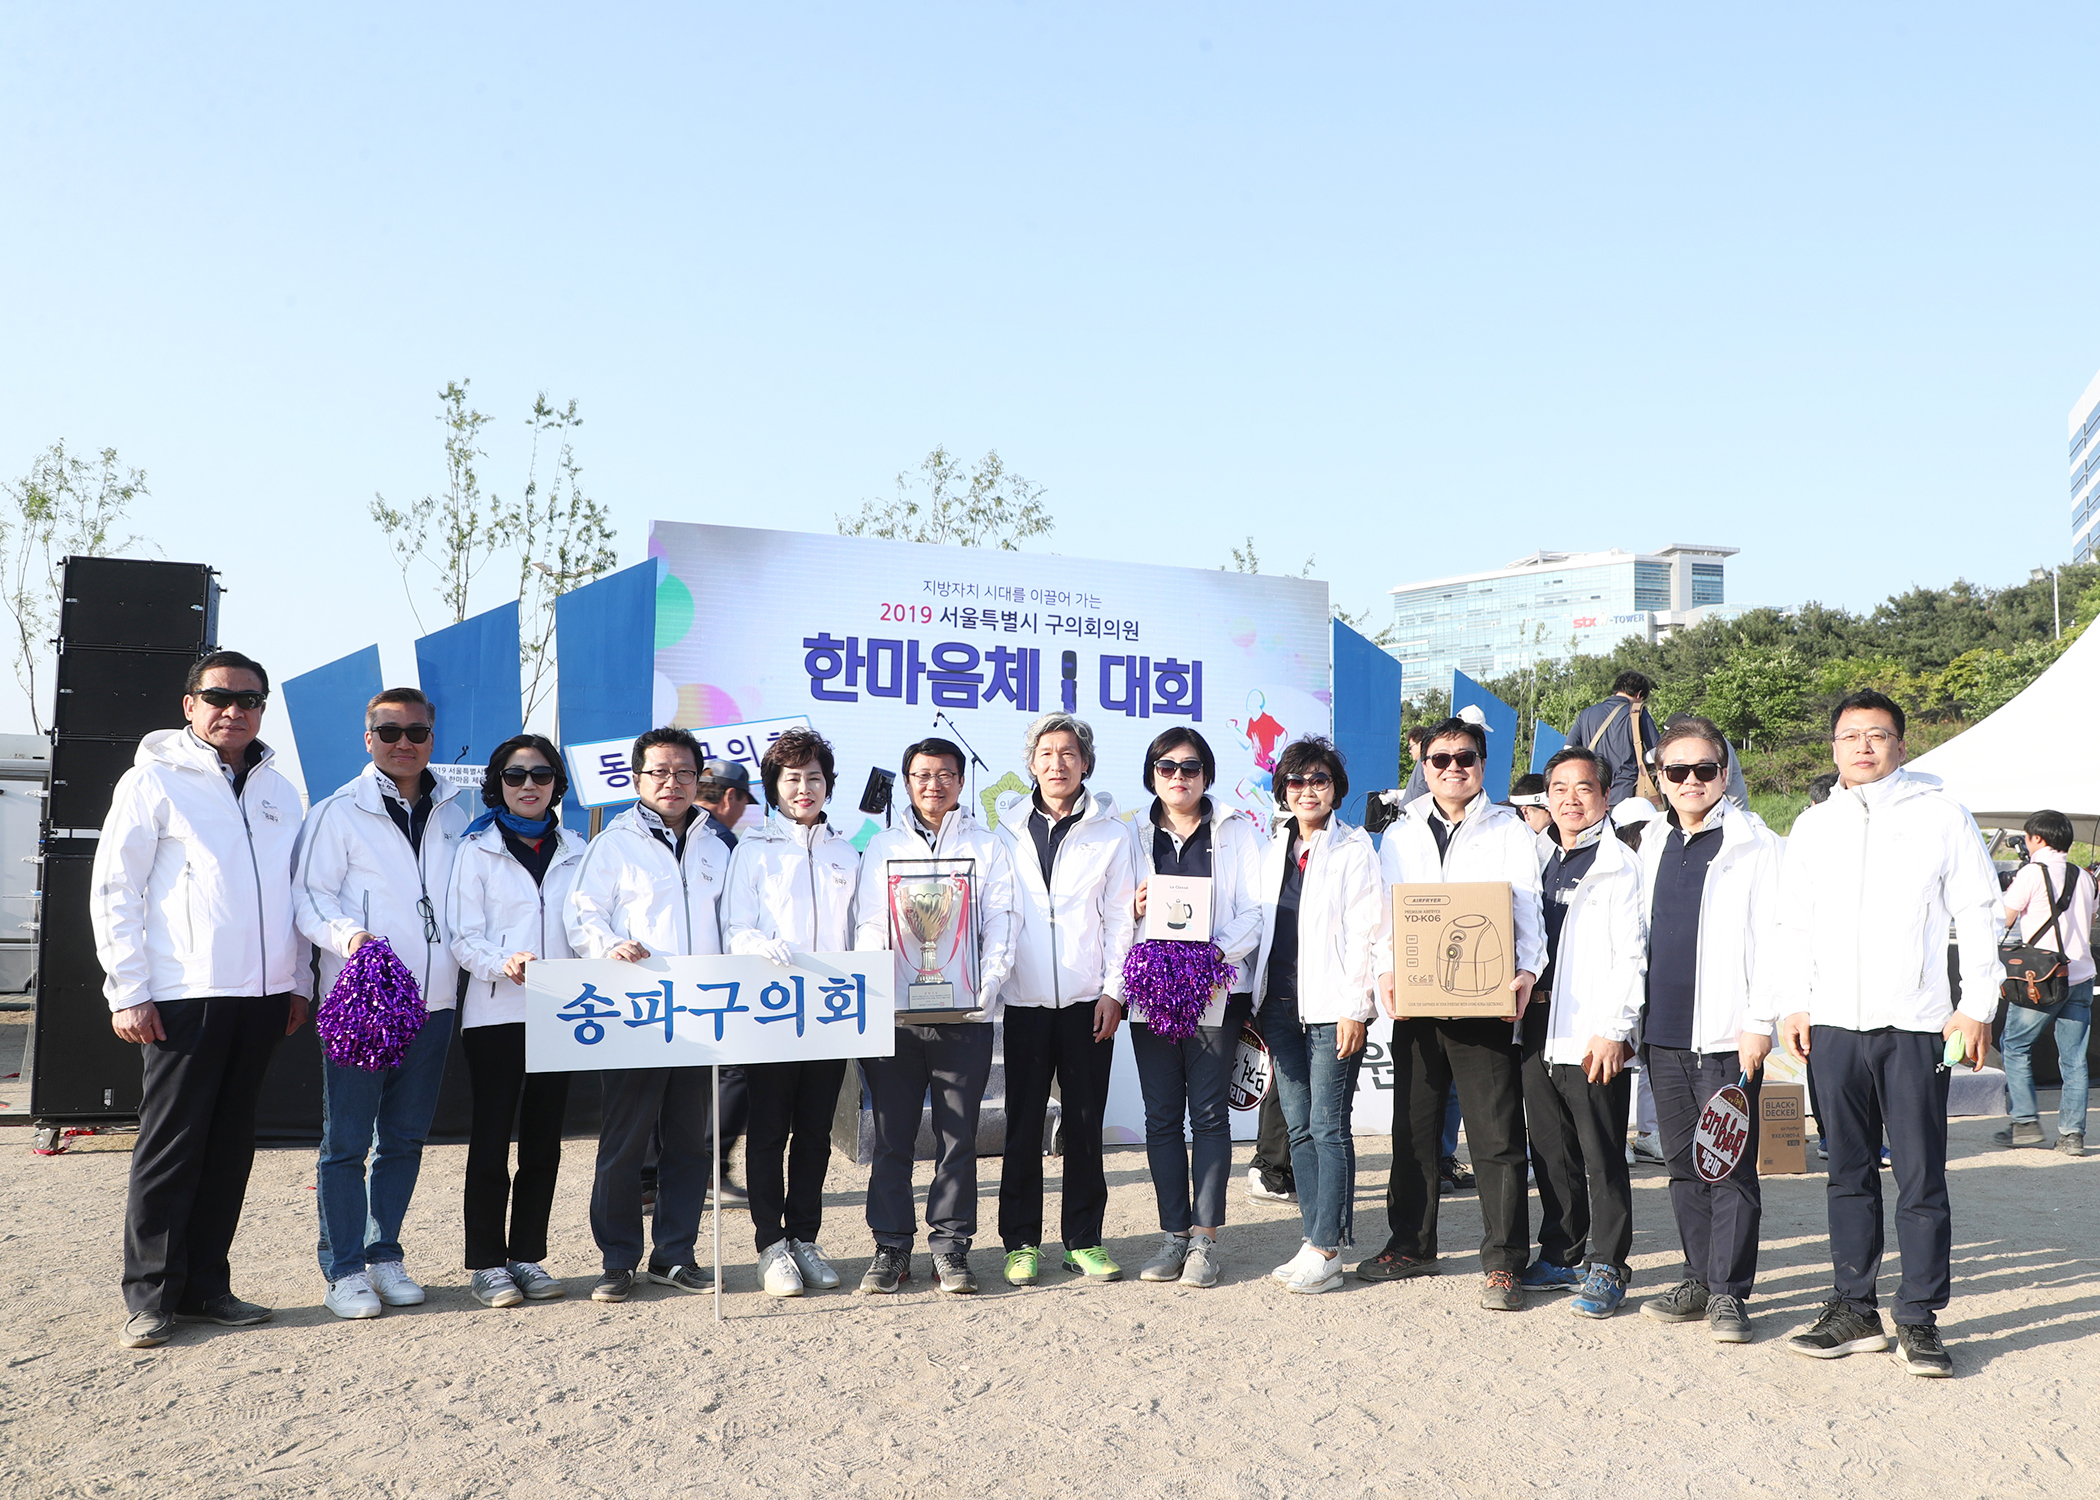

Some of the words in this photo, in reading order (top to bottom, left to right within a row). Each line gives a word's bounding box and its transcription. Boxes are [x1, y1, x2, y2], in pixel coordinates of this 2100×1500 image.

[923, 580, 979, 599] 지방자치
[983, 586, 1026, 604] 시대를
[1030, 589, 1071, 607] 이끌어
[1075, 592, 1102, 610] 가는
[880, 602, 932, 624] 2019
[939, 606, 1038, 634] 서울특별시
[1044, 614, 1140, 642] 구의회의원
[1404, 915, 1441, 923] YD-K06
[556, 974, 866, 1045] 송파구의회
[1765, 1101, 1795, 1109] BLACK+
[1765, 1109, 1796, 1117] DECKER
